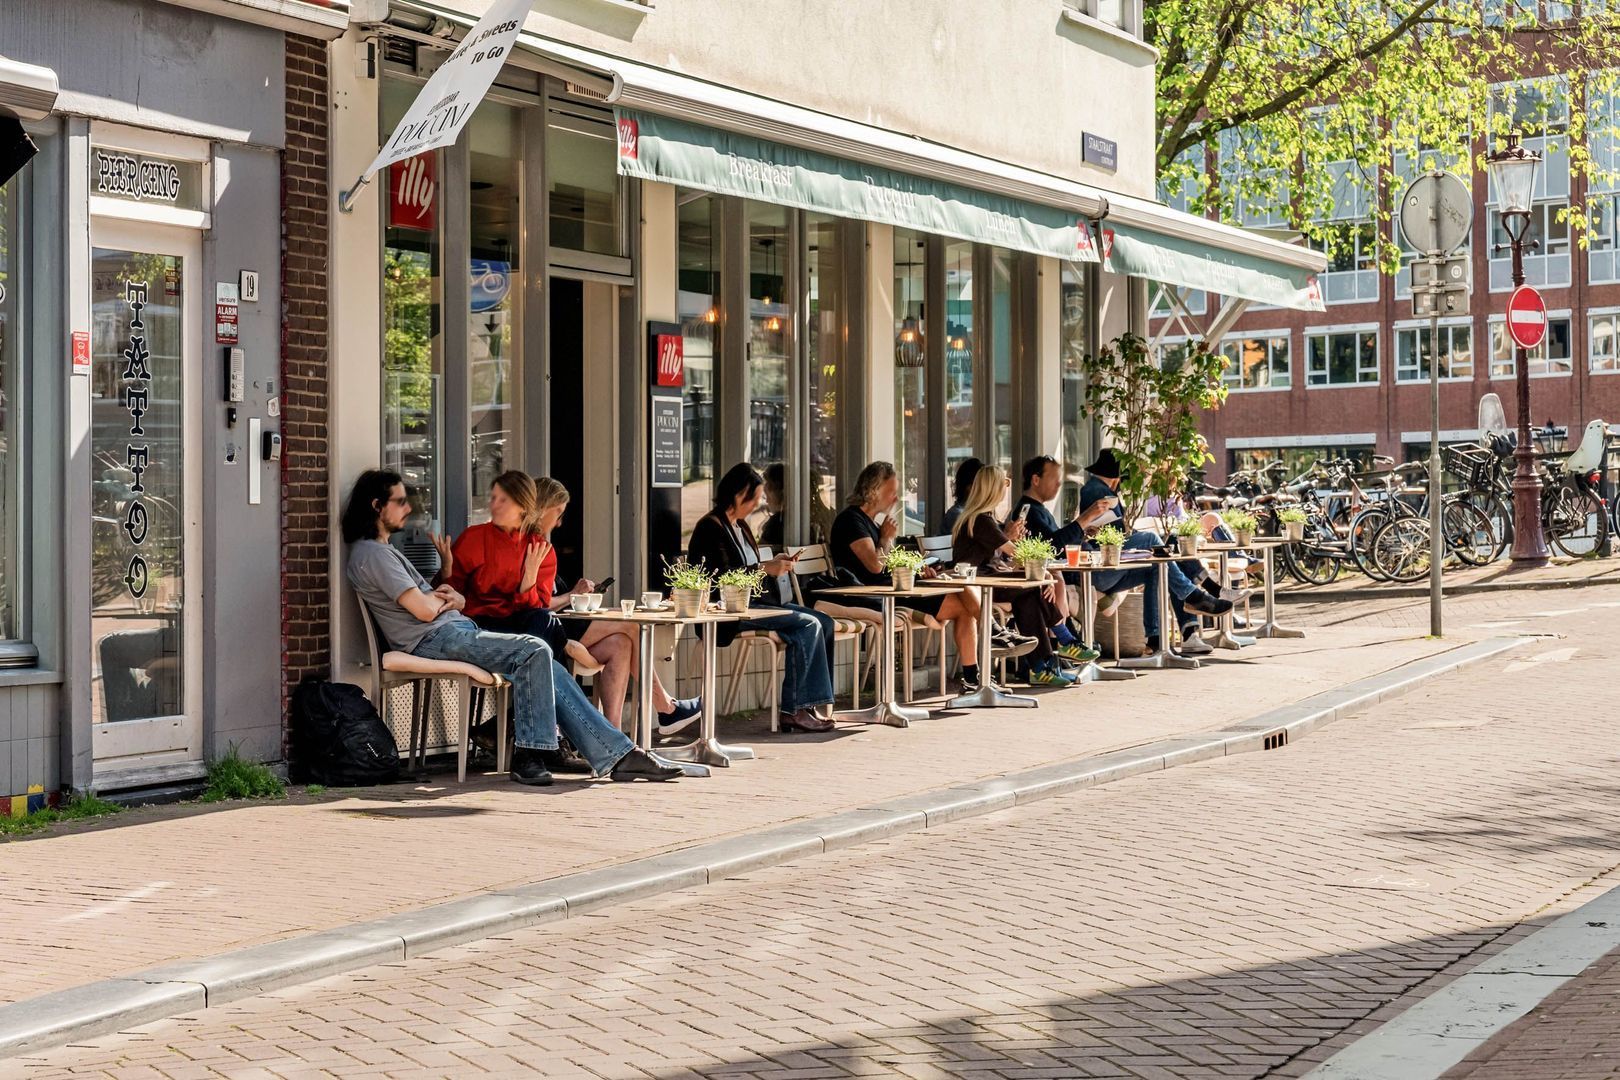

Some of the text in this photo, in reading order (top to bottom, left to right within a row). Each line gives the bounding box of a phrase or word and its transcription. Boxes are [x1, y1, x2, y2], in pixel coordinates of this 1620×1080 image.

[619, 124, 636, 155] illy
[1088, 137, 1113, 155] STAALSTRAAT
[97, 151, 180, 201] PIERCING
[727, 152, 794, 187] Breakfast
[398, 157, 434, 220] illy
[246, 275, 255, 298] 19
[217, 306, 238, 316] ALARM
[660, 343, 682, 381] illy
[122, 280, 152, 600] TATTOO
